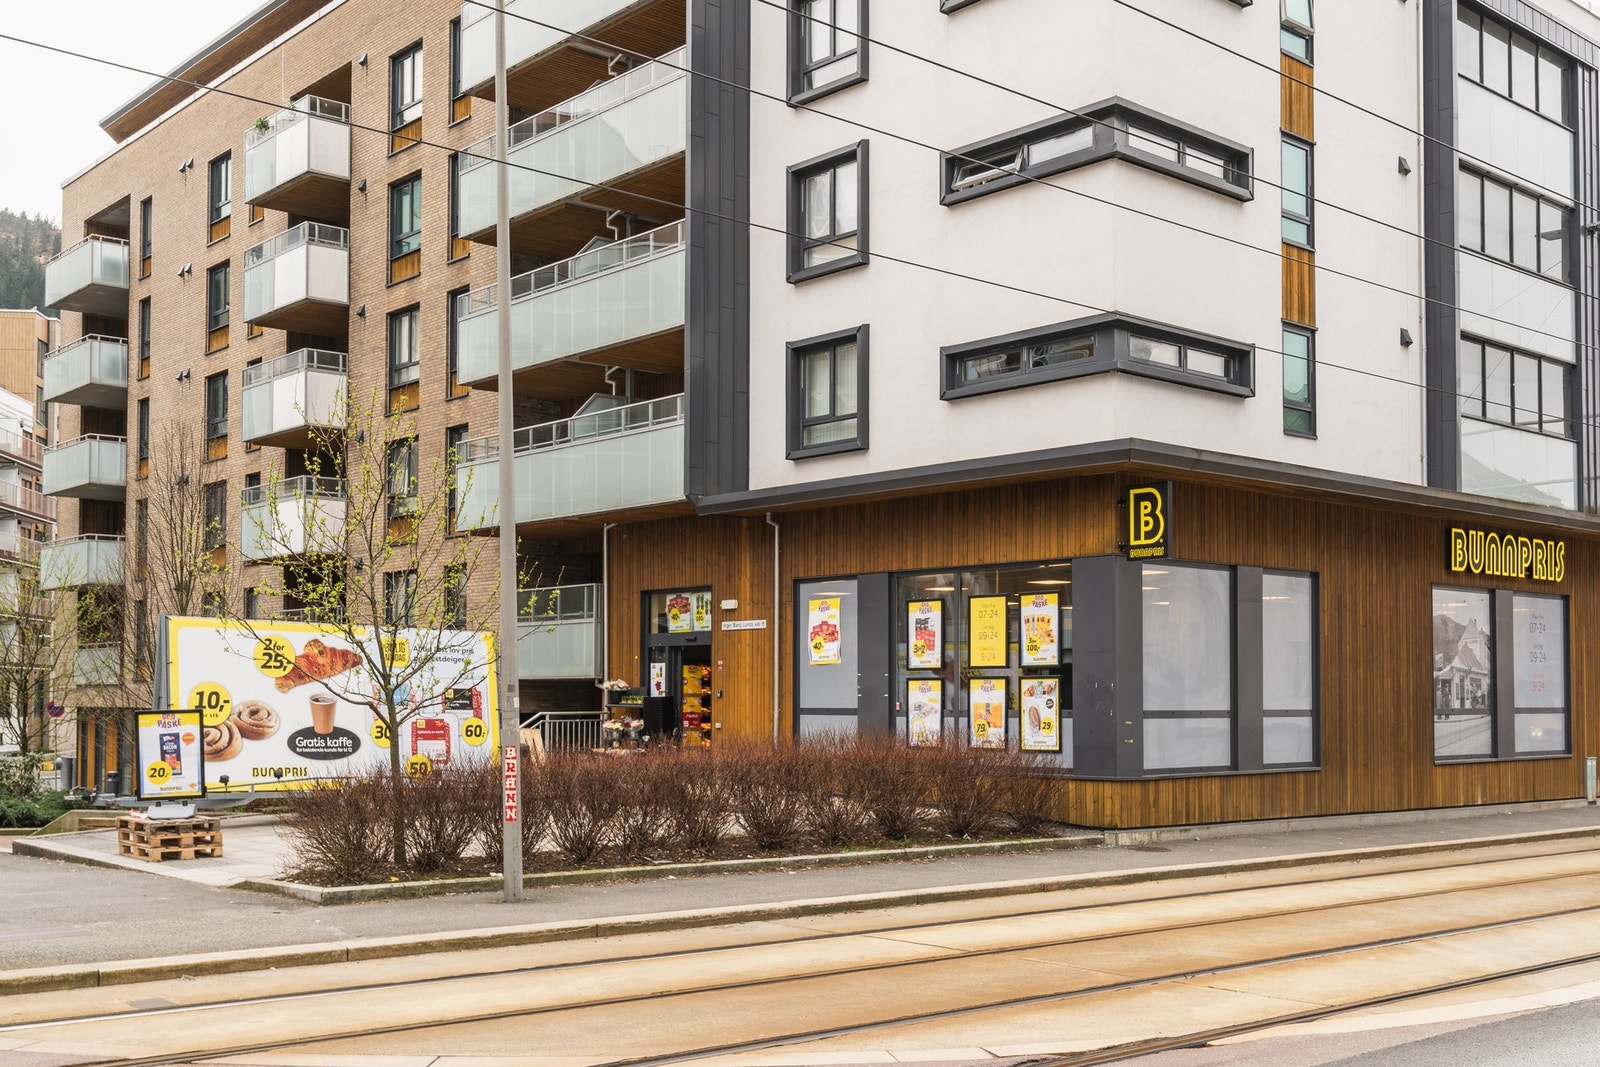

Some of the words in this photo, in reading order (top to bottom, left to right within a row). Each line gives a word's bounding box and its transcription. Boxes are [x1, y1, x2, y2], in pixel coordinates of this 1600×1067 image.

[1452, 527, 1565, 583] BUNNPRIS
[1529, 622, 1546, 634] 07-24
[263, 638, 273, 651] 2
[273, 642, 285, 651] for
[195, 690, 230, 712] 10,-
[295, 736, 326, 747] Gratis
[326, 736, 353, 747] kaffe
[252, 767, 308, 777] BUNPRIS
[505, 745, 517, 822] BRANN
